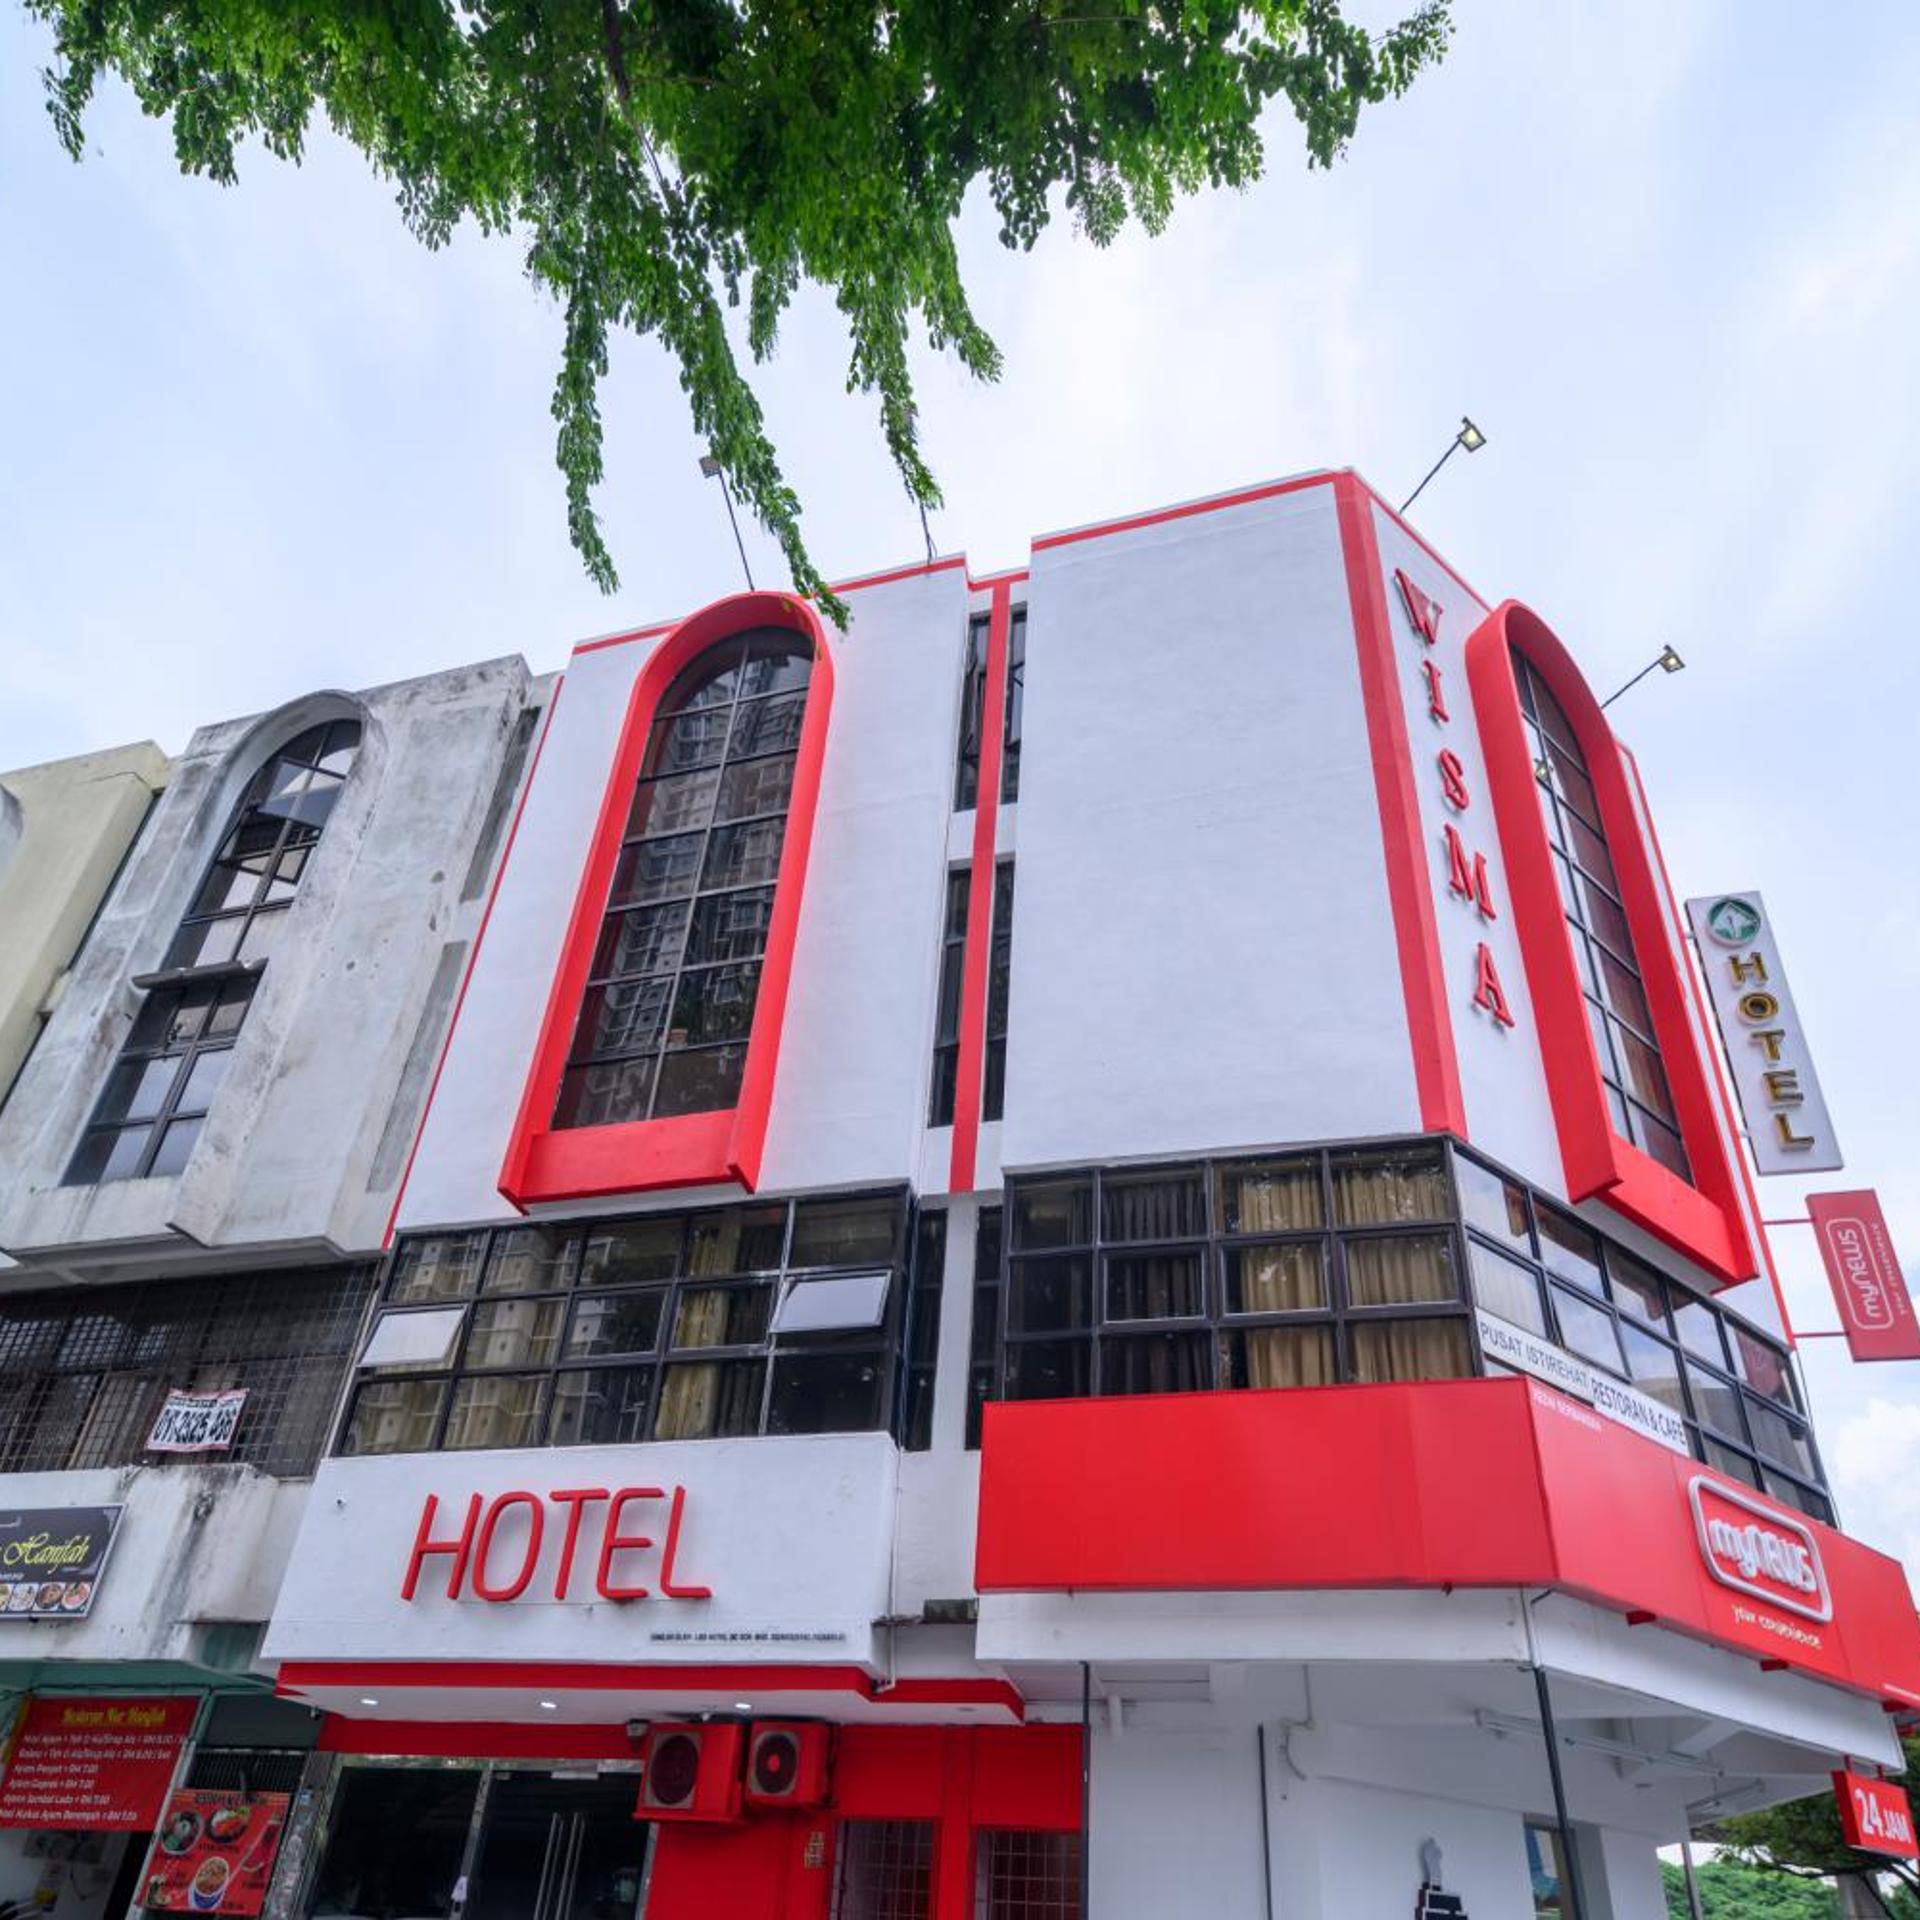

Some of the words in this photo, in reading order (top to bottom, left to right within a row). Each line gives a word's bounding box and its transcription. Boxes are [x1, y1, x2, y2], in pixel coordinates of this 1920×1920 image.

[1395, 567, 1514, 1028] WISMA
[1728, 952, 1815, 1153] HOTEL
[1479, 1321, 1522, 1357] PUSAT
[1590, 1378, 1649, 1427] RESTORAN
[401, 1484, 712, 1602] HOTEL
[1855, 1787, 1884, 1838] 24
[1883, 1808, 1912, 1844] JAM
